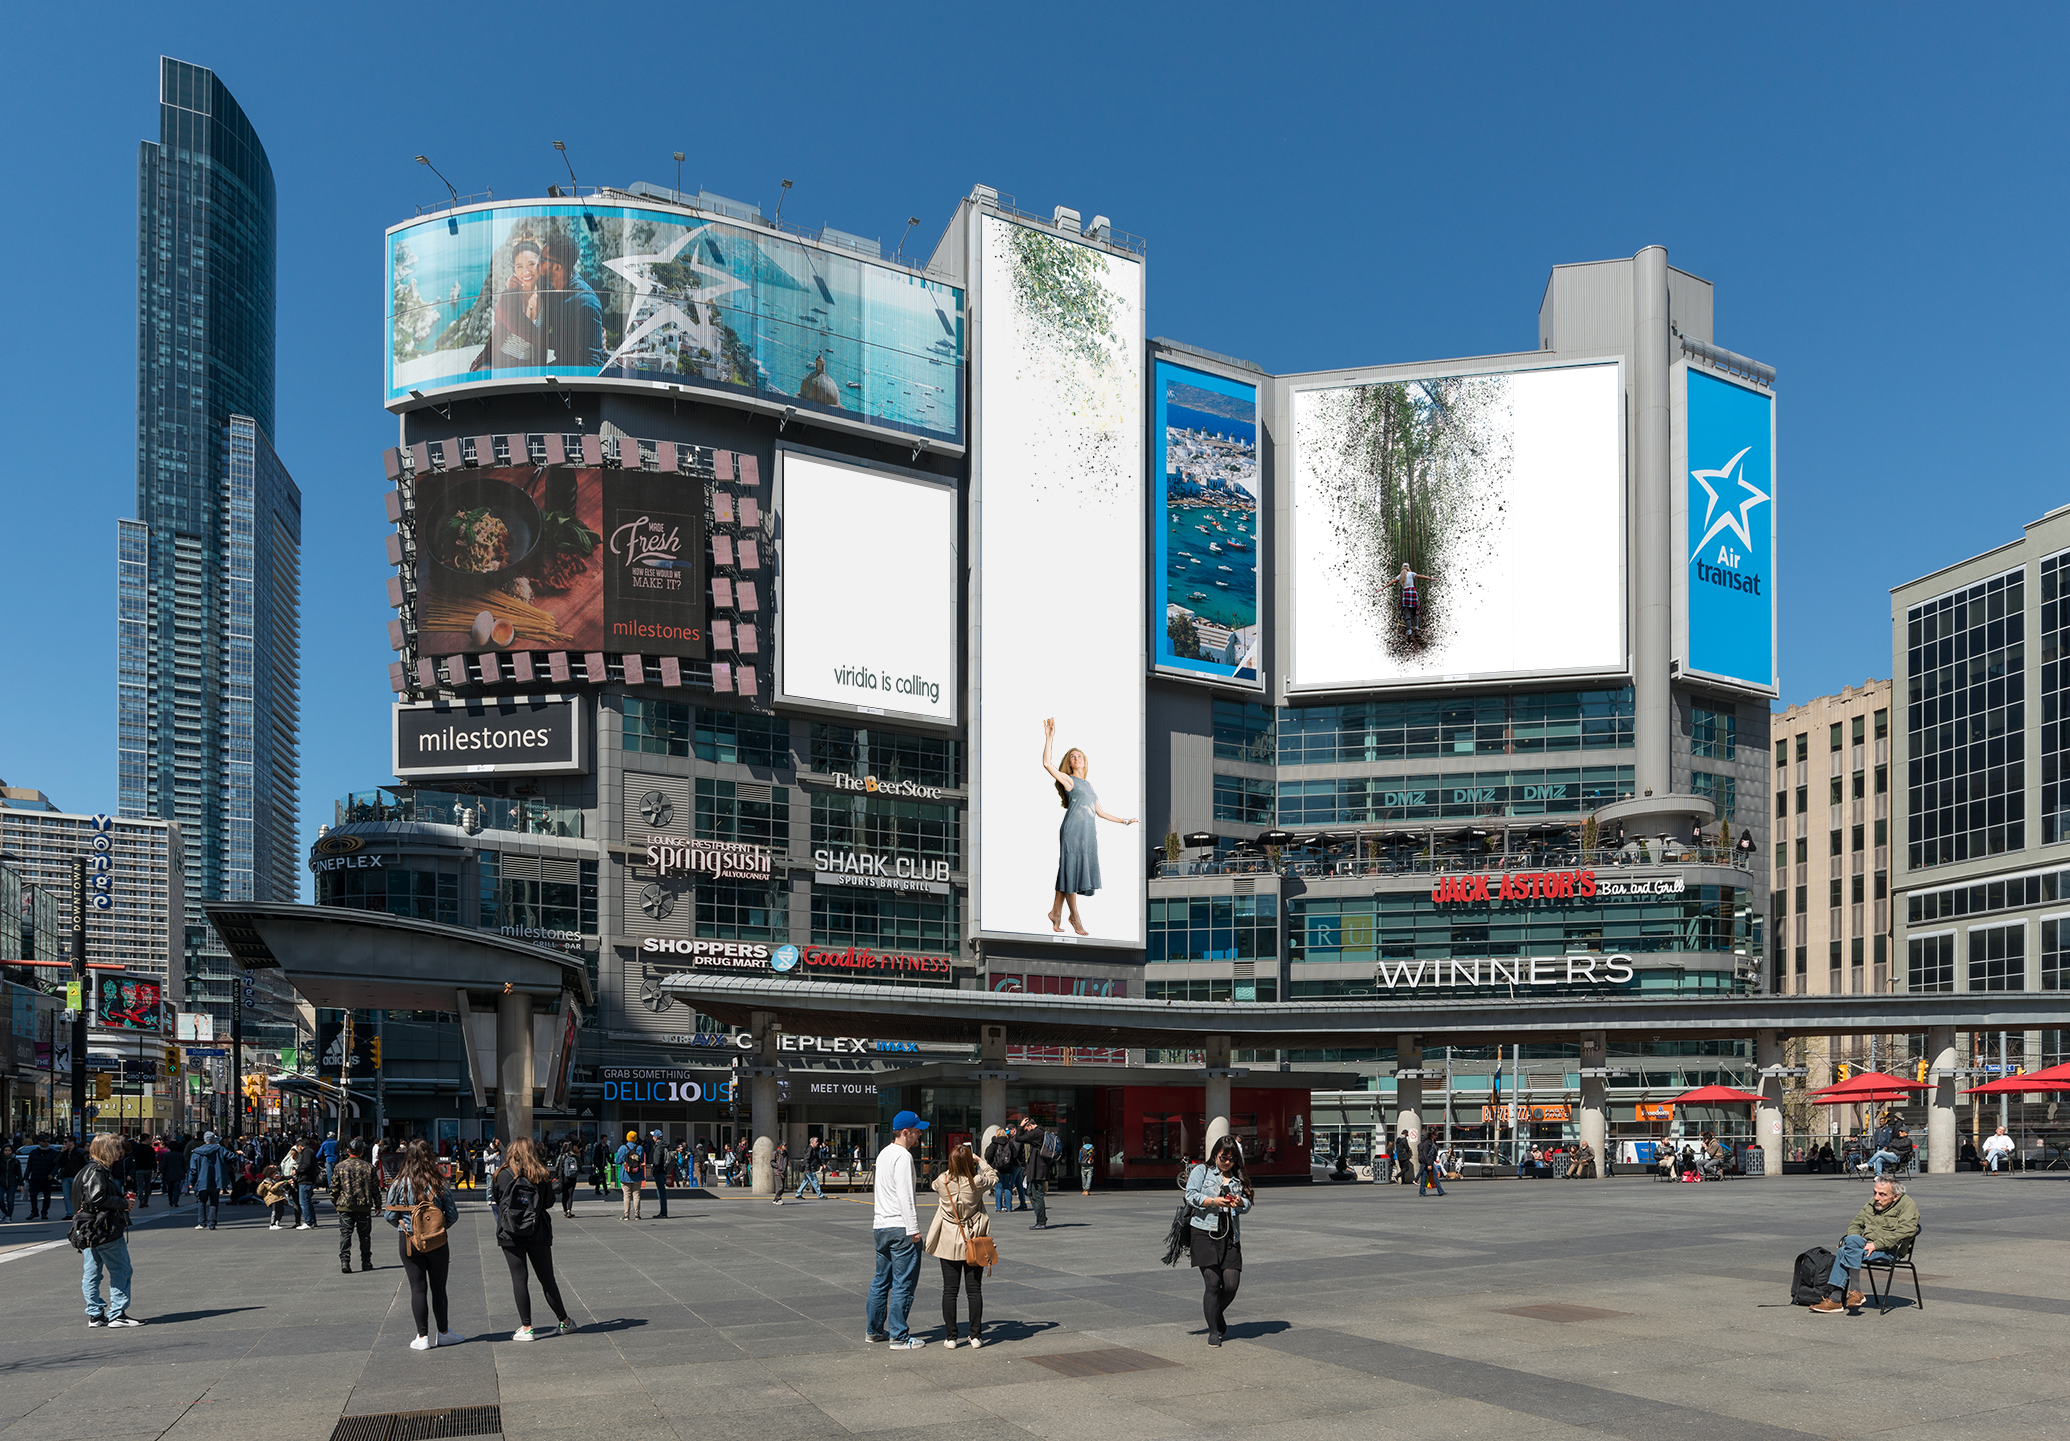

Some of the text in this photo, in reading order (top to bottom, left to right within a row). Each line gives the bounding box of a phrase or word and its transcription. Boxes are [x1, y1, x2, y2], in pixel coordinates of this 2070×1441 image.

[648, 522, 665, 533] MADE
[610, 515, 682, 567] Fresh
[1717, 545, 1741, 569] Air
[632, 567, 682, 579] HOW ELSE WOULD WE
[633, 576, 682, 590] MAKE IT?
[1696, 558, 1761, 596] transat
[613, 619, 701, 641] milestones
[833, 665, 940, 703] viridia is calling
[419, 726, 551, 752] milestones
[1384, 790, 1427, 807] DMZ
[1453, 787, 1496, 803] DMZ
[1523, 784, 1567, 800] DMZ
[647, 835, 753, 853] LOUNGE RESTAURANT
[92, 813, 112, 911] Yonge
[311, 854, 382, 873] CINEPLEX
[814, 849, 950, 883] SHARK CLUB
[838, 874, 930, 892] SPORTS BAR GRILL
[1432, 869, 1685, 903] JACK ASTOR'S Bar and Grill
[73, 863, 82, 931] DOWNTOWN
[500, 923, 582, 941] milestones
[1318, 923, 1365, 946] R U
[533, 940, 582, 950] GRILL BAR
[642, 937, 768, 959] SHOPPERS
[694, 955, 768, 968] DRUG MART
[803, 945, 950, 973] GoodLife FITNESS
[1378, 954, 1635, 989] WINNERS
[735, 1032, 918, 1054] CEPLEX IMAX
[604, 1069, 690, 1080] GRAB SOMETHING
[811, 1083, 839, 1094] MEET
[841, 1083, 863, 1095] YOU
